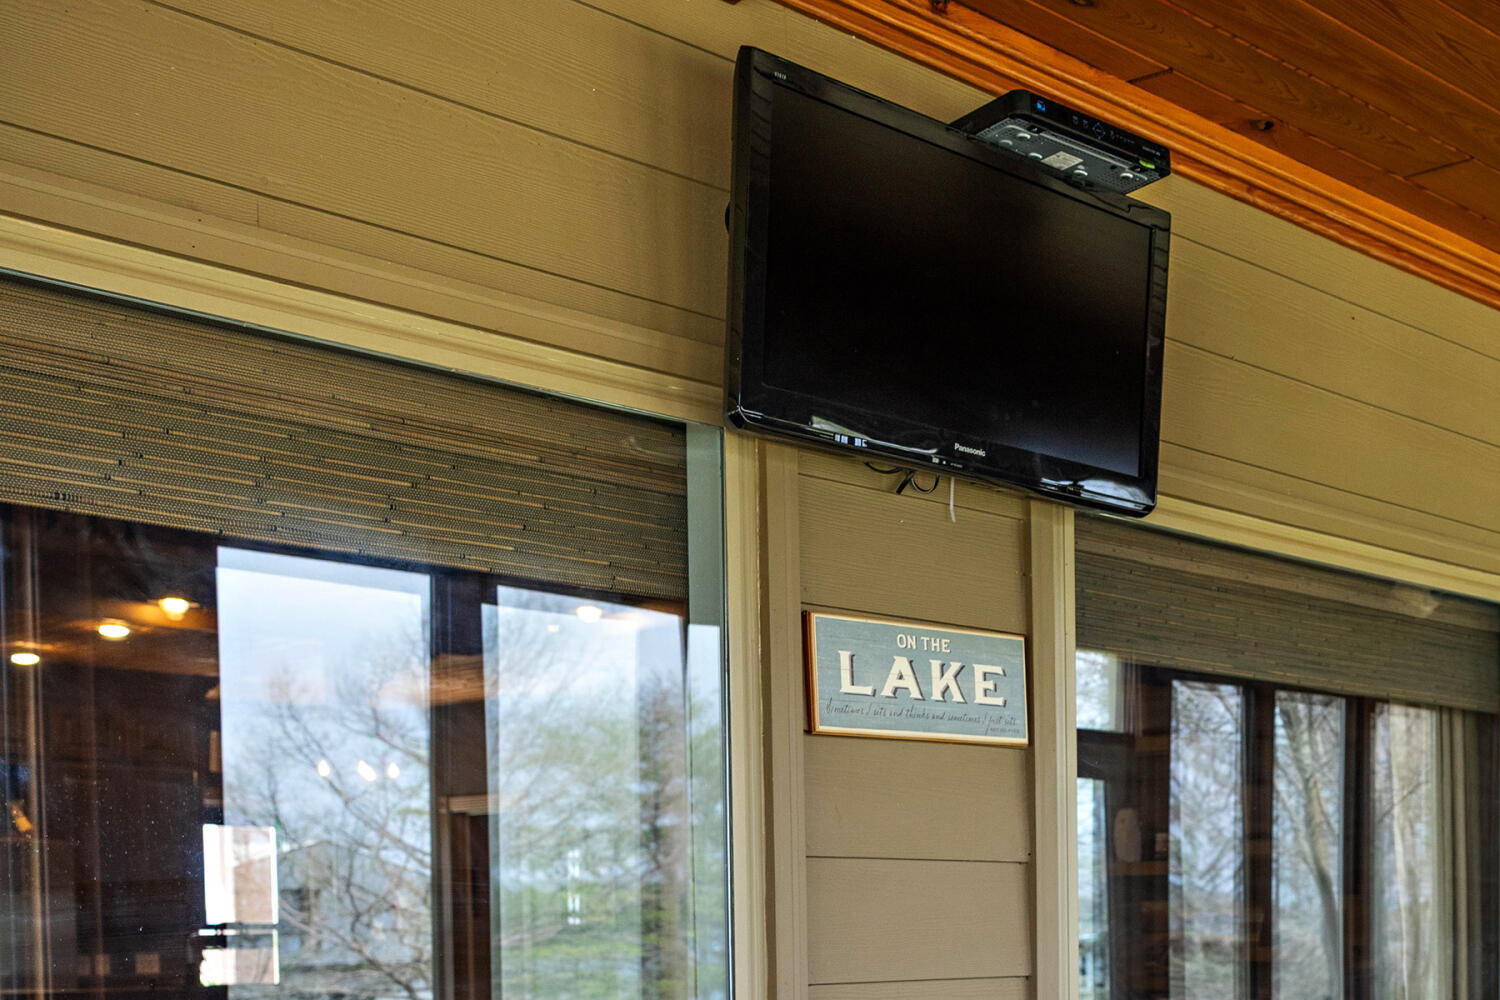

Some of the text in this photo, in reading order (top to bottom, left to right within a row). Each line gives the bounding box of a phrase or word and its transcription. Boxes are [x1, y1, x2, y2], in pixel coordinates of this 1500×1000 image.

[954, 442, 986, 457] Panasonic
[897, 634, 952, 653] ON THE
[838, 649, 1007, 708] LAKE
